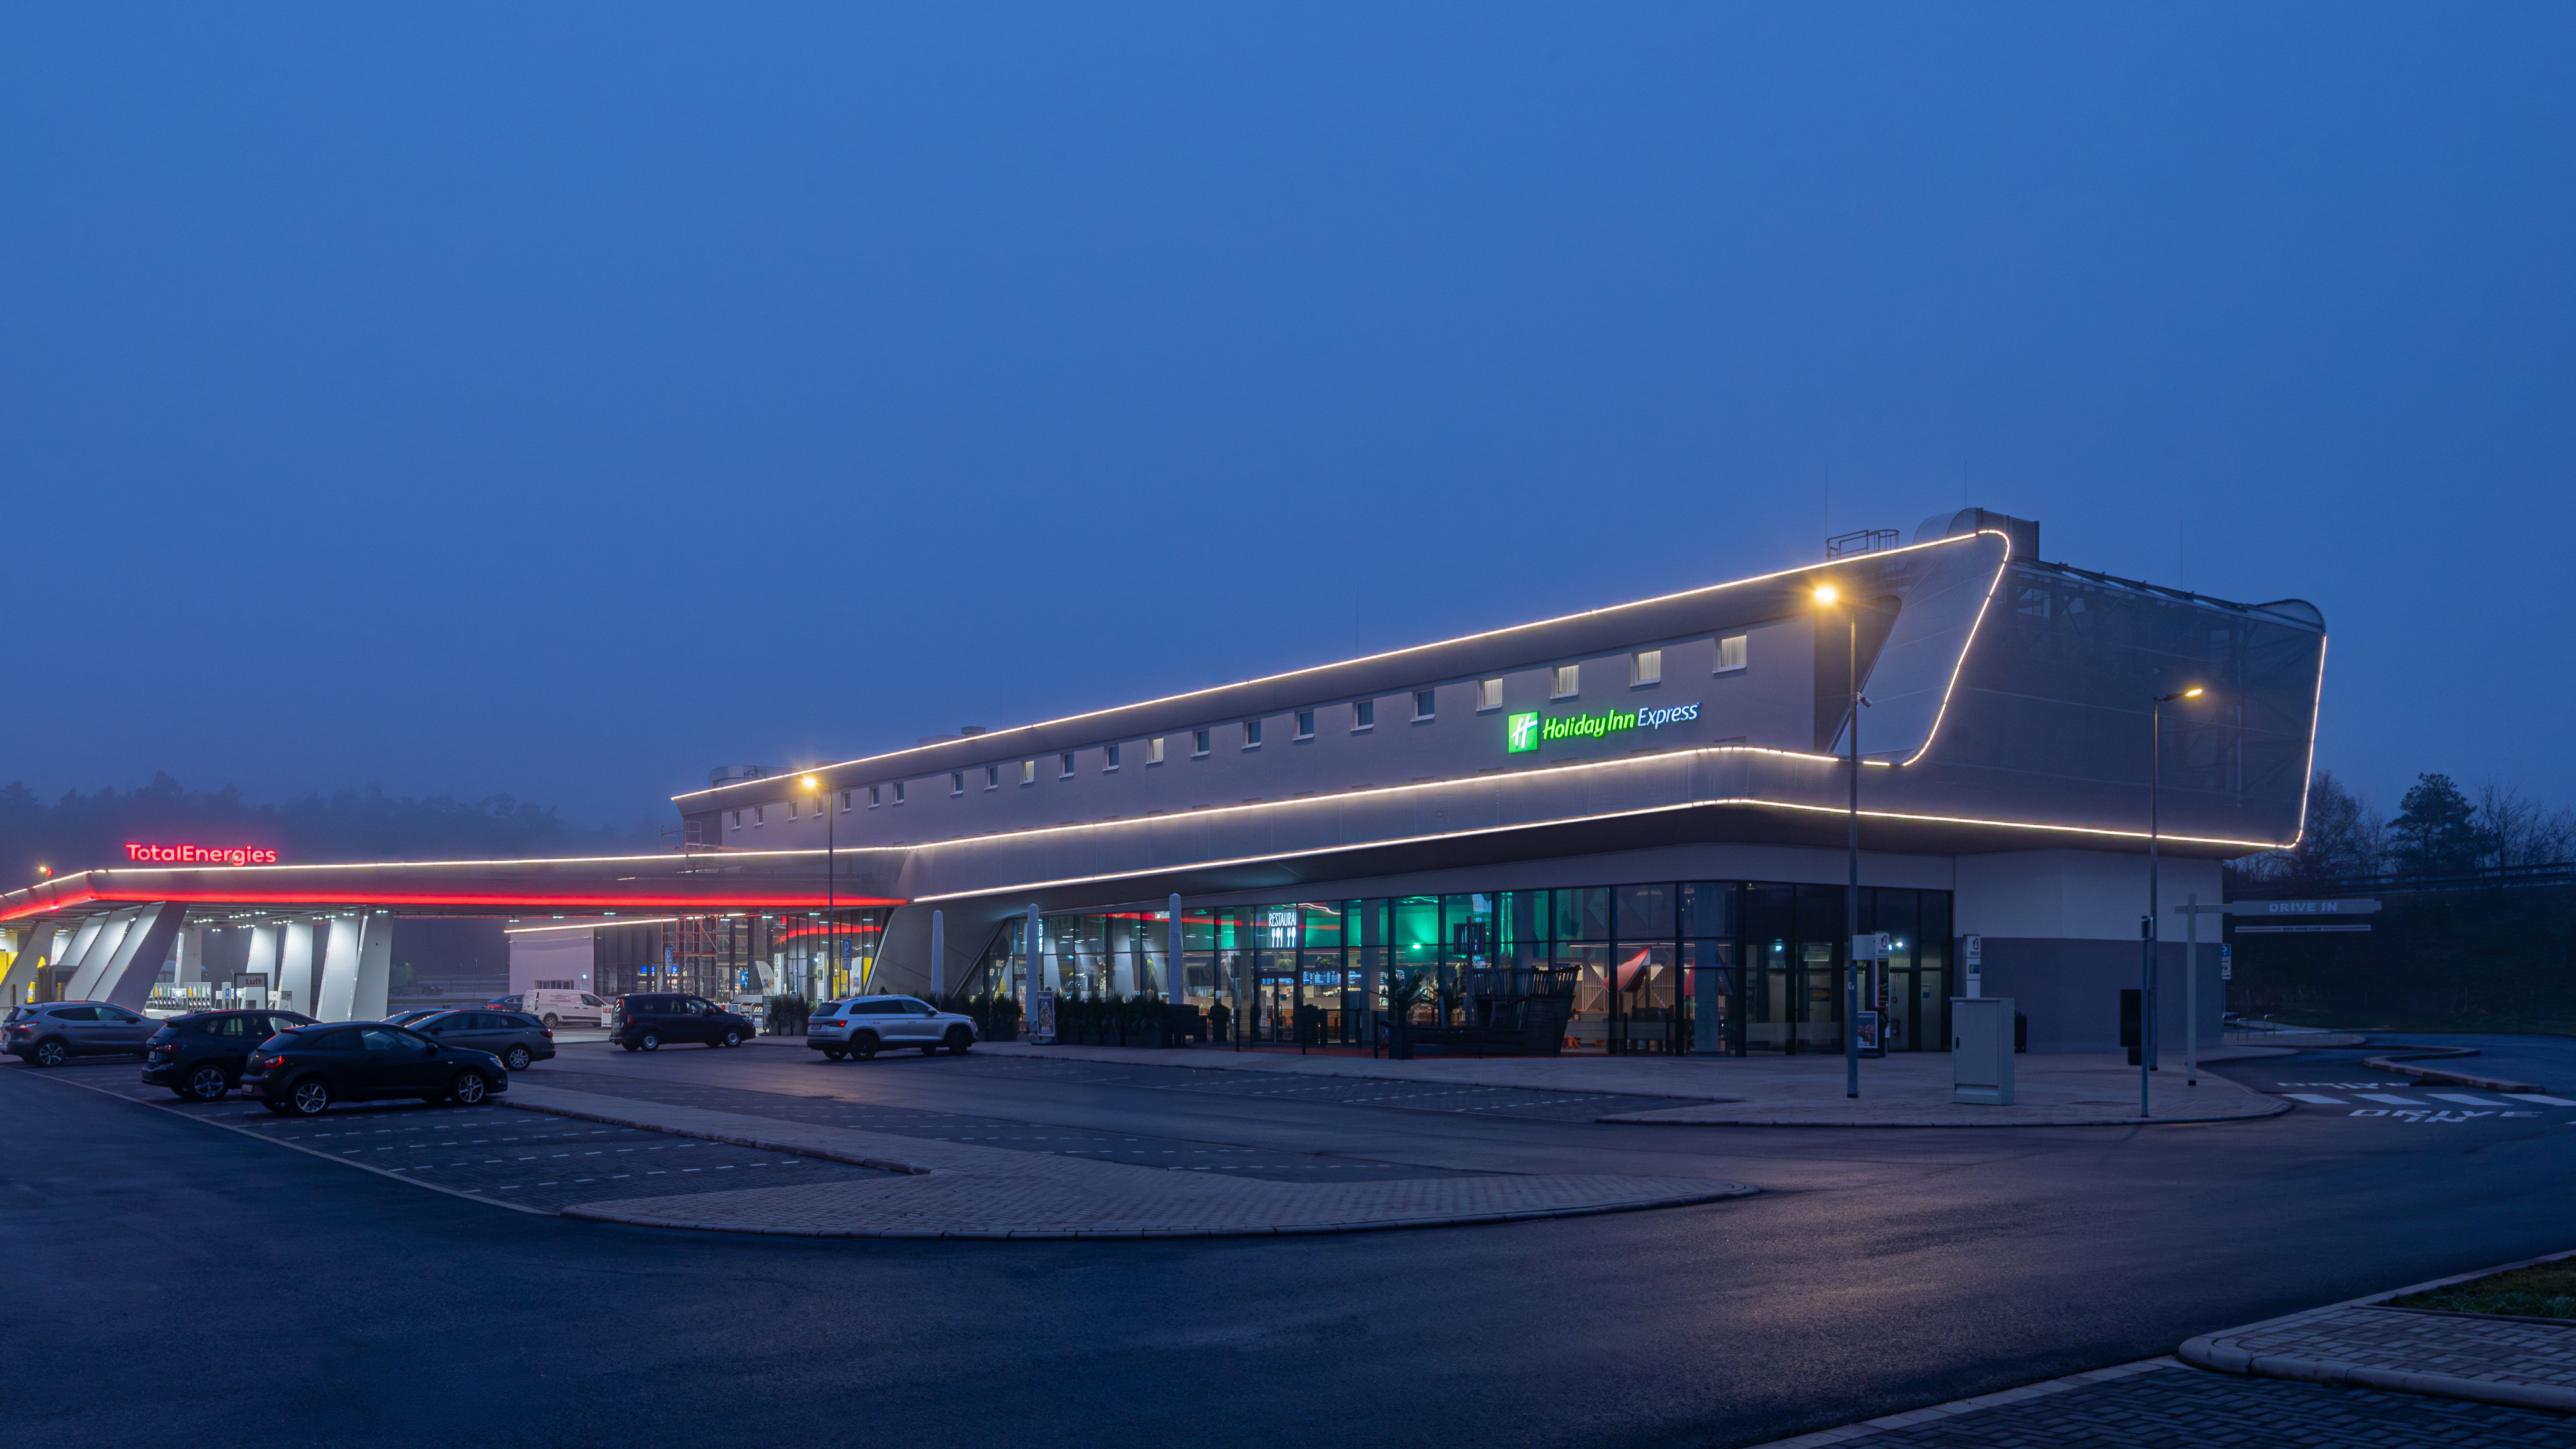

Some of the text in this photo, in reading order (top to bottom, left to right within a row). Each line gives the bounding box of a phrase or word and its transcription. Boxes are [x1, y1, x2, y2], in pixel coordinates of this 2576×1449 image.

[1543, 704, 1699, 739] Holiday Inn Express
[125, 844, 276, 867] TotalEnergies
[2269, 902, 2337, 912] DRIVE IN
[2349, 1109, 2544, 1117] DRIVE
